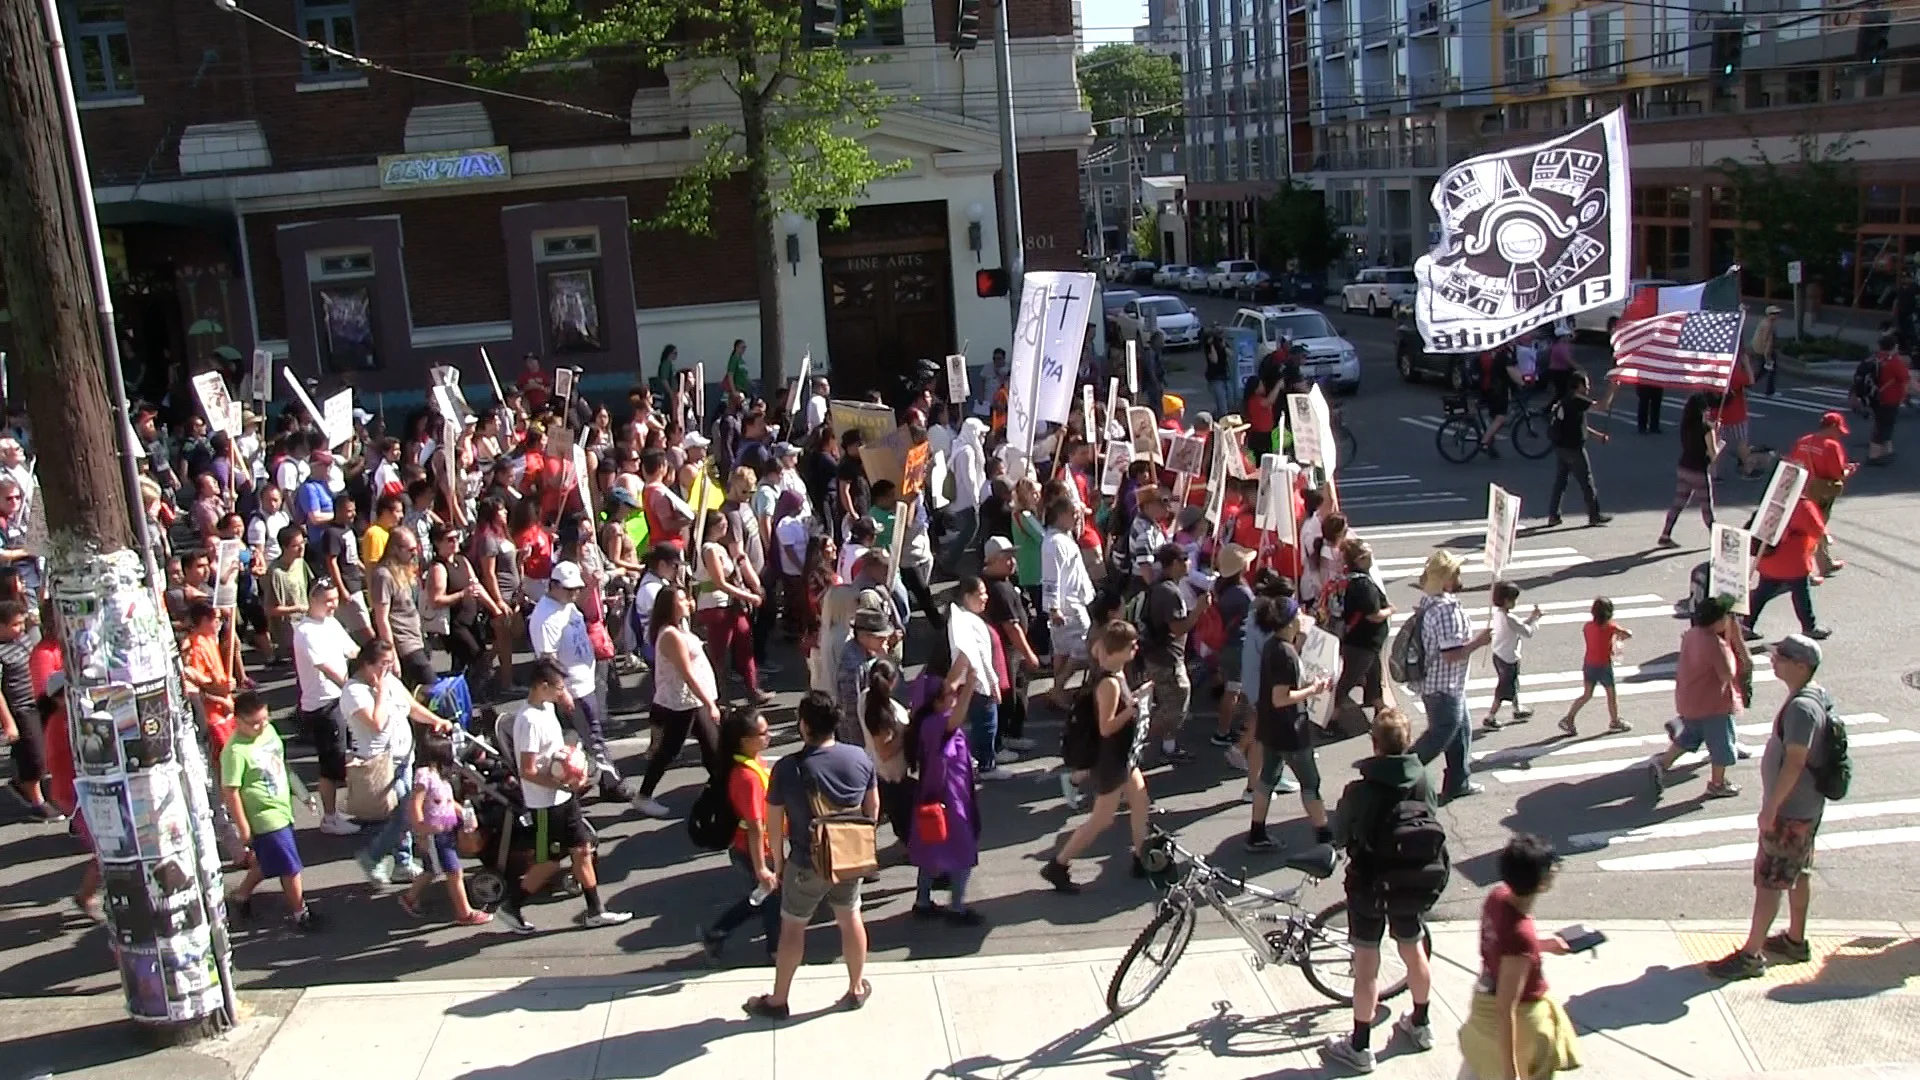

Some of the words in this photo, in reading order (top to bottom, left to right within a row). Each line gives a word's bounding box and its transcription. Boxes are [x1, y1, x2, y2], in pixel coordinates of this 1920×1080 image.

[1026, 235, 1056, 250] 801
[848, 257, 878, 270] FINE
[887, 254, 923, 268] ARTS
